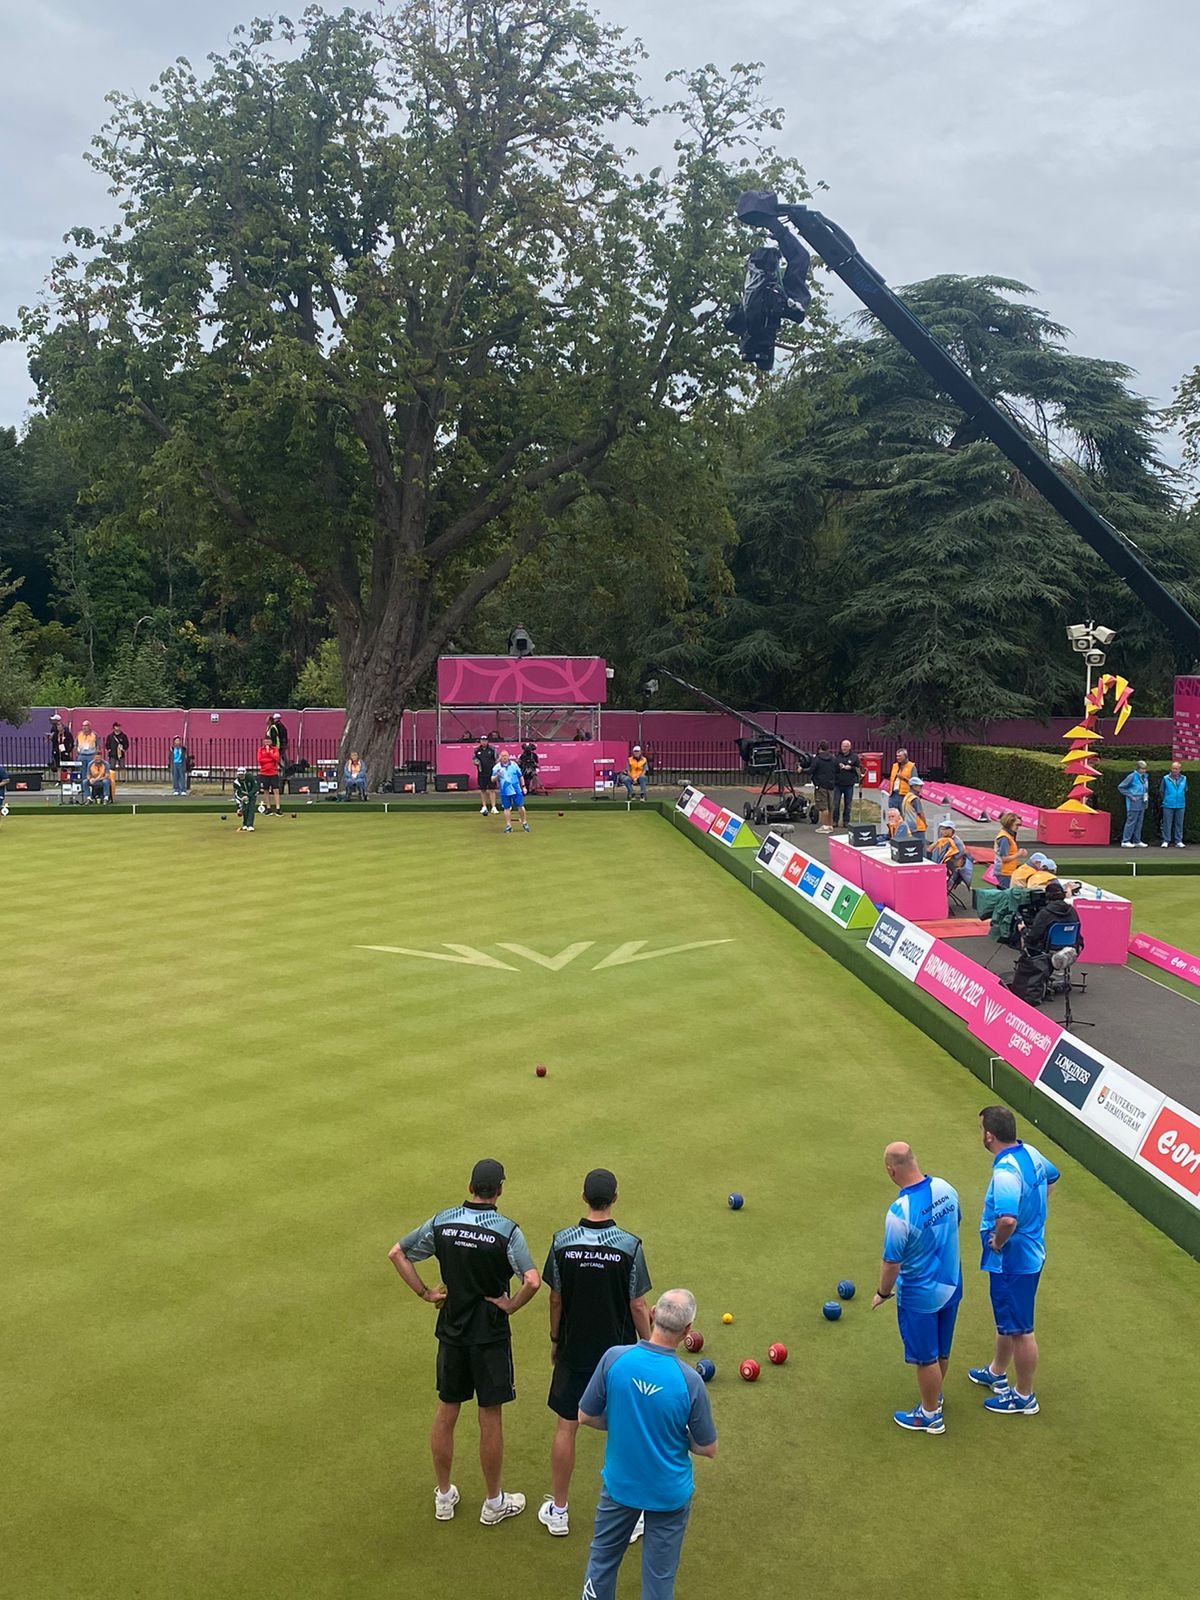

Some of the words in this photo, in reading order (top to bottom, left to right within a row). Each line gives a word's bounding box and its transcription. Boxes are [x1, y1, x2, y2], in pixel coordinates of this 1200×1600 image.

[897, 938, 924, 966] #B2022
[923, 953, 970, 996] BIRMINGHAM
[1005, 1012, 1052, 1053] commonwealth
[1008, 1033, 1033, 1057] games
[1054, 1053, 1091, 1085] LONGINES
[1104, 1102, 1141, 1132] BIRMINGHAM
[921, 1195, 950, 1217] ANDERSON
[923, 1204, 956, 1230] SCOTLAND
[441, 1228, 459, 1237] NEW
[459, 1229, 496, 1244] ZEALAND
[564, 1250, 583, 1259] NEW
[583, 1251, 621, 1262] ZEALAND
